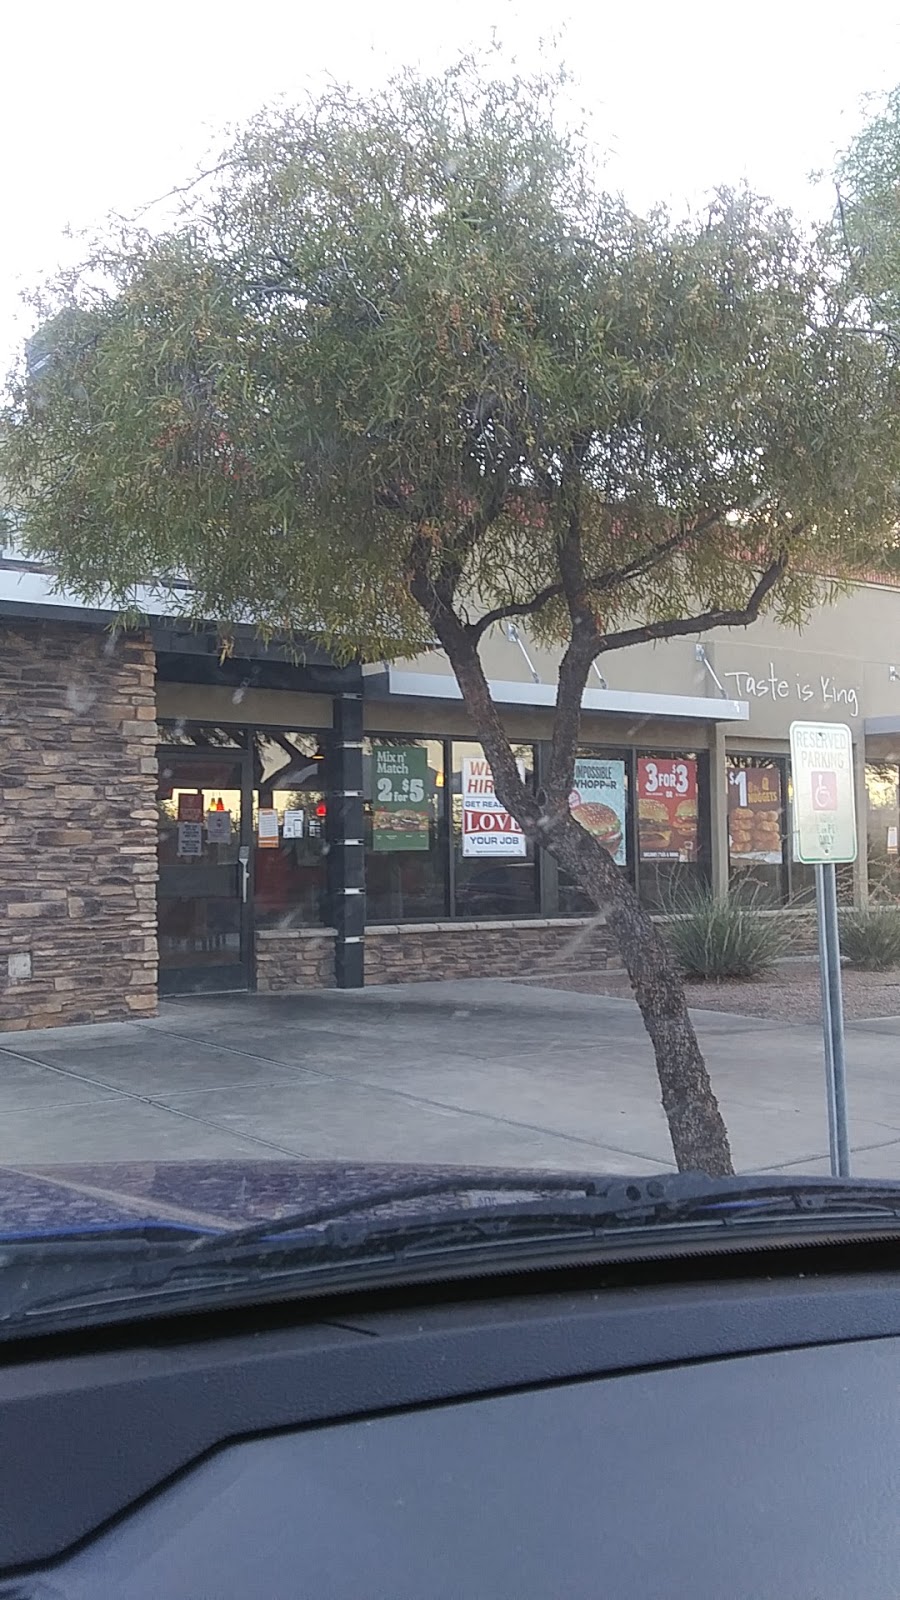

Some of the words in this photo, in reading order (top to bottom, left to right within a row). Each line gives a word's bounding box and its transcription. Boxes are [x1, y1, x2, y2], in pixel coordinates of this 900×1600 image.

[725, 662, 789, 701] Taste
[796, 673, 814, 701] is
[820, 676, 858, 717] King
[796, 731, 847, 749] RESERVED
[377, 751, 396, 763] Mix
[801, 751, 845, 769] PARKING
[377, 763, 409, 774] Match
[575, 765, 612, 780] IMPOSSIBLE
[645, 762, 658, 792] 3
[658, 773, 676, 788] FOR
[377, 777, 393, 802] 2
[393, 791, 409, 803] for
[402, 777, 424, 803] $5
[467, 779, 494, 794] HIR
[465, 800, 481, 808] GET
[466, 811, 523, 833] LOVE
[470, 836, 498, 845] YOUR
[499, 836, 519, 845] JOB
